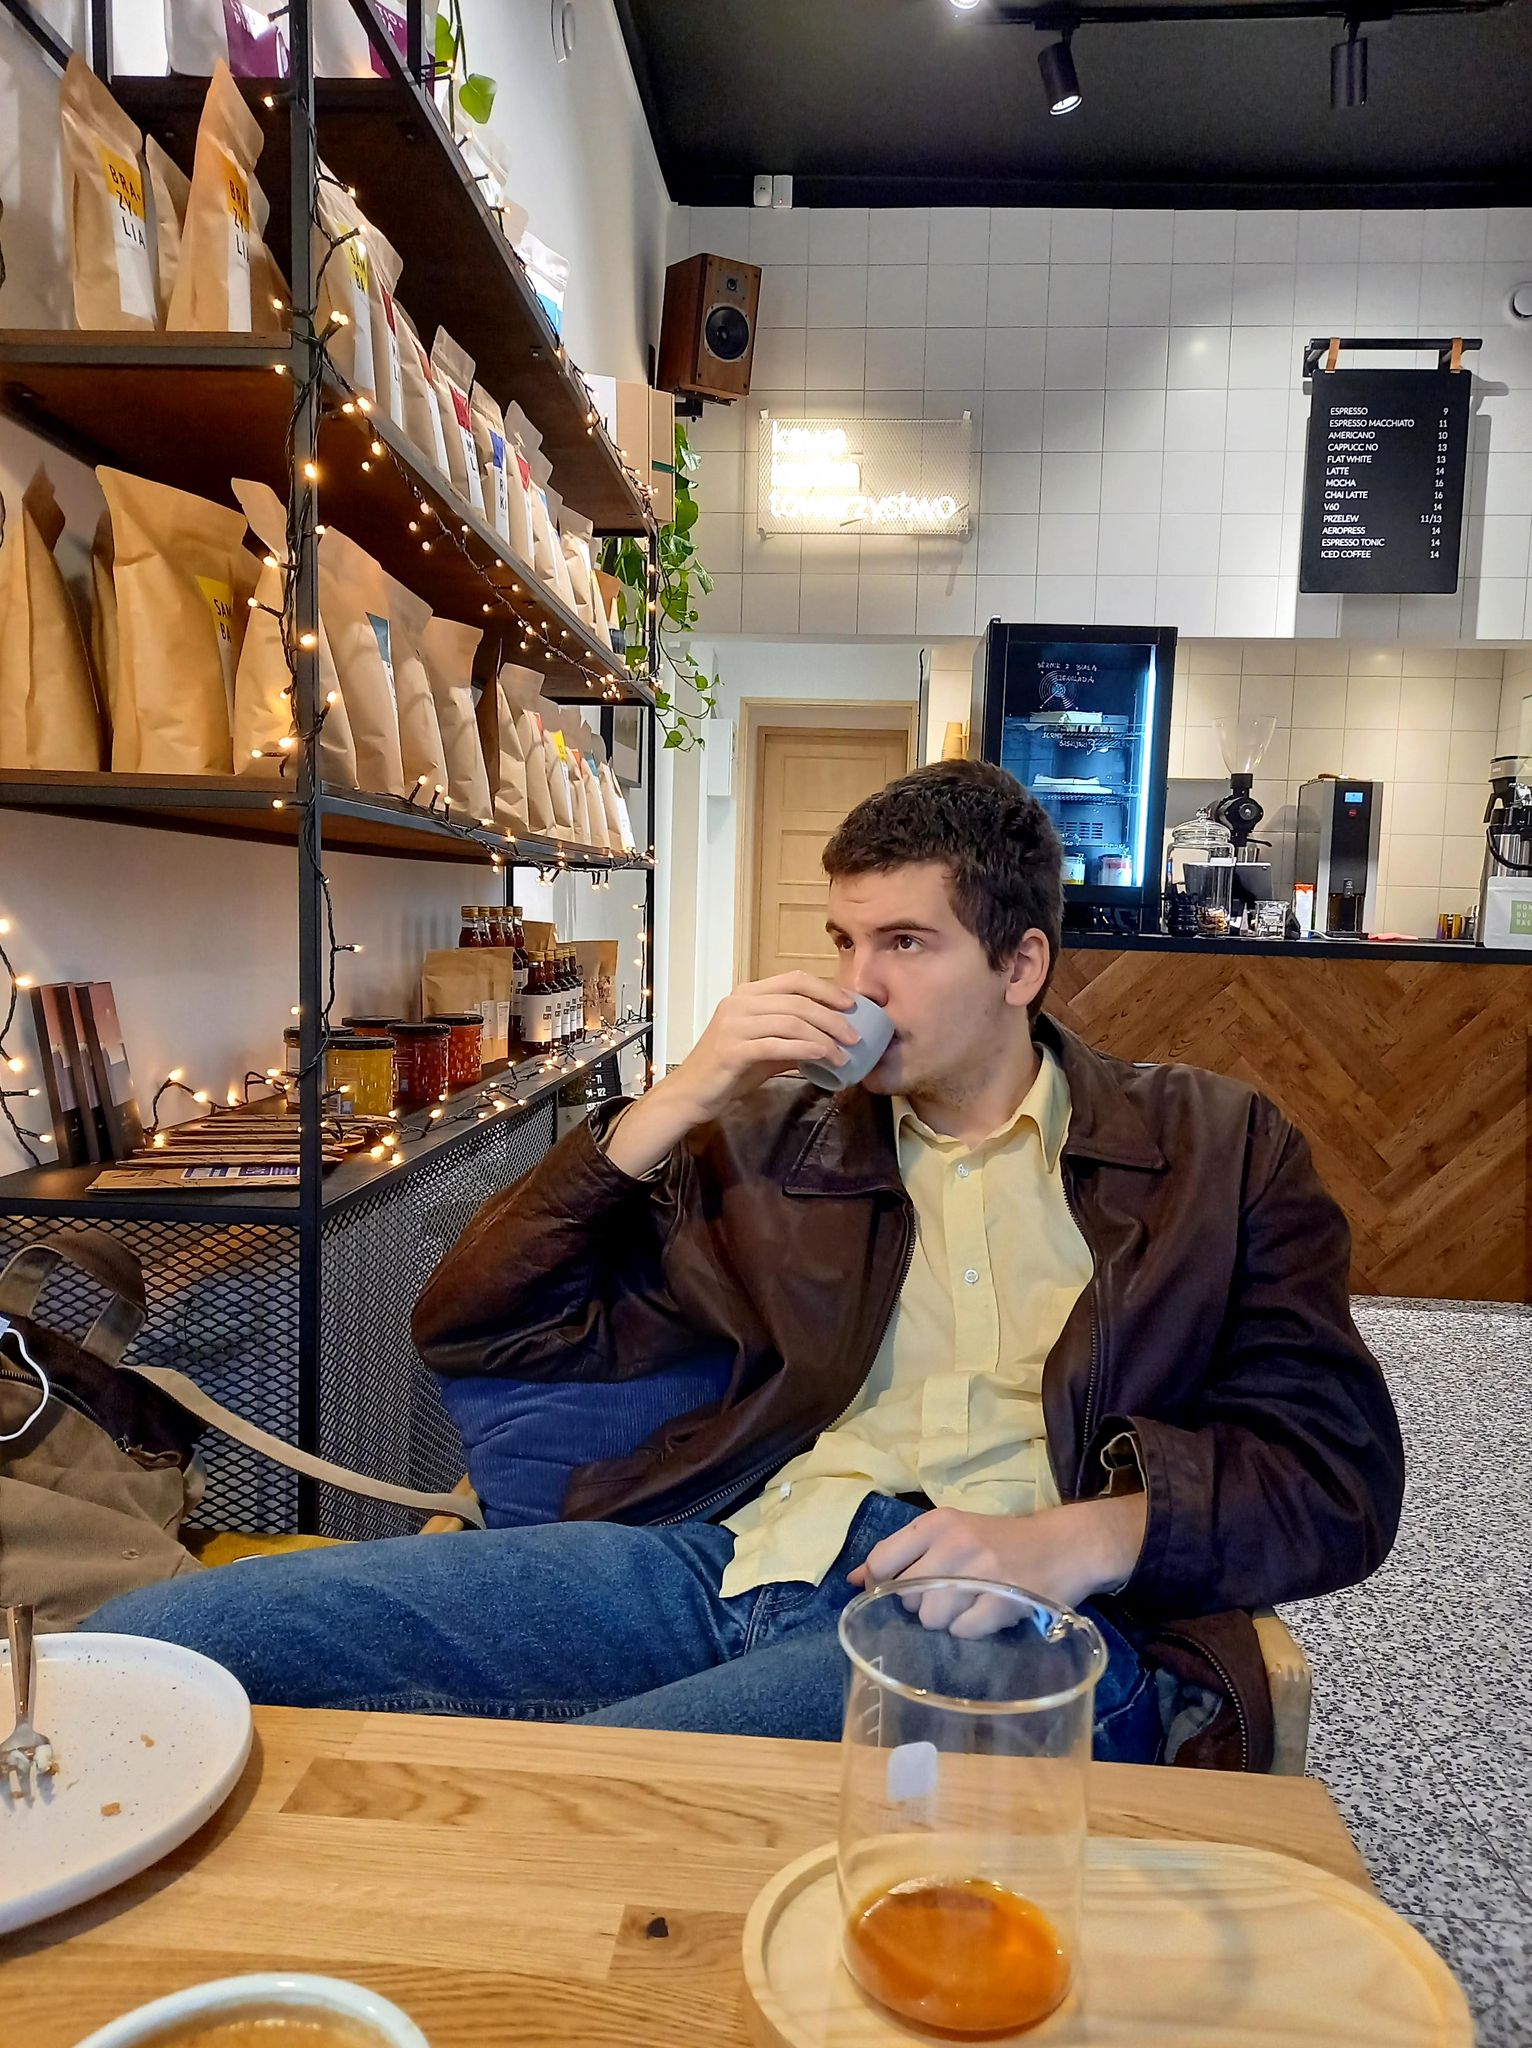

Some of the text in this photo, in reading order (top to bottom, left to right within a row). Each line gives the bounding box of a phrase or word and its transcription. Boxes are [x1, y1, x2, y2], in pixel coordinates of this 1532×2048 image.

[122, 216, 146, 250] LIA
[1330, 407, 1448, 416] ESPRESSO 9
[1329, 419, 1447, 428] ESPRESSO MACCHIATO 11
[1328, 431, 1448, 440] AMERICANO 10
[1327, 443, 1447, 452] CAPPUCCNO 13
[1327, 455, 1446, 464] FLAT WHITE 13
[1326, 467, 1444, 476] LATTE 14
[1325, 479, 1444, 488] MOCHA 16
[1325, 491, 1443, 500] CHAI LATTE 16
[1324, 503, 1442, 512] V60 14
[1323, 514, 1442, 524] PRZELEW 11/13
[1322, 526, 1440, 535] AEROPRESS 14
[1321, 538, 1440, 547] ESPRESSO TONIC 14
[1320, 550, 1439, 559] ICED COFFEE 14
